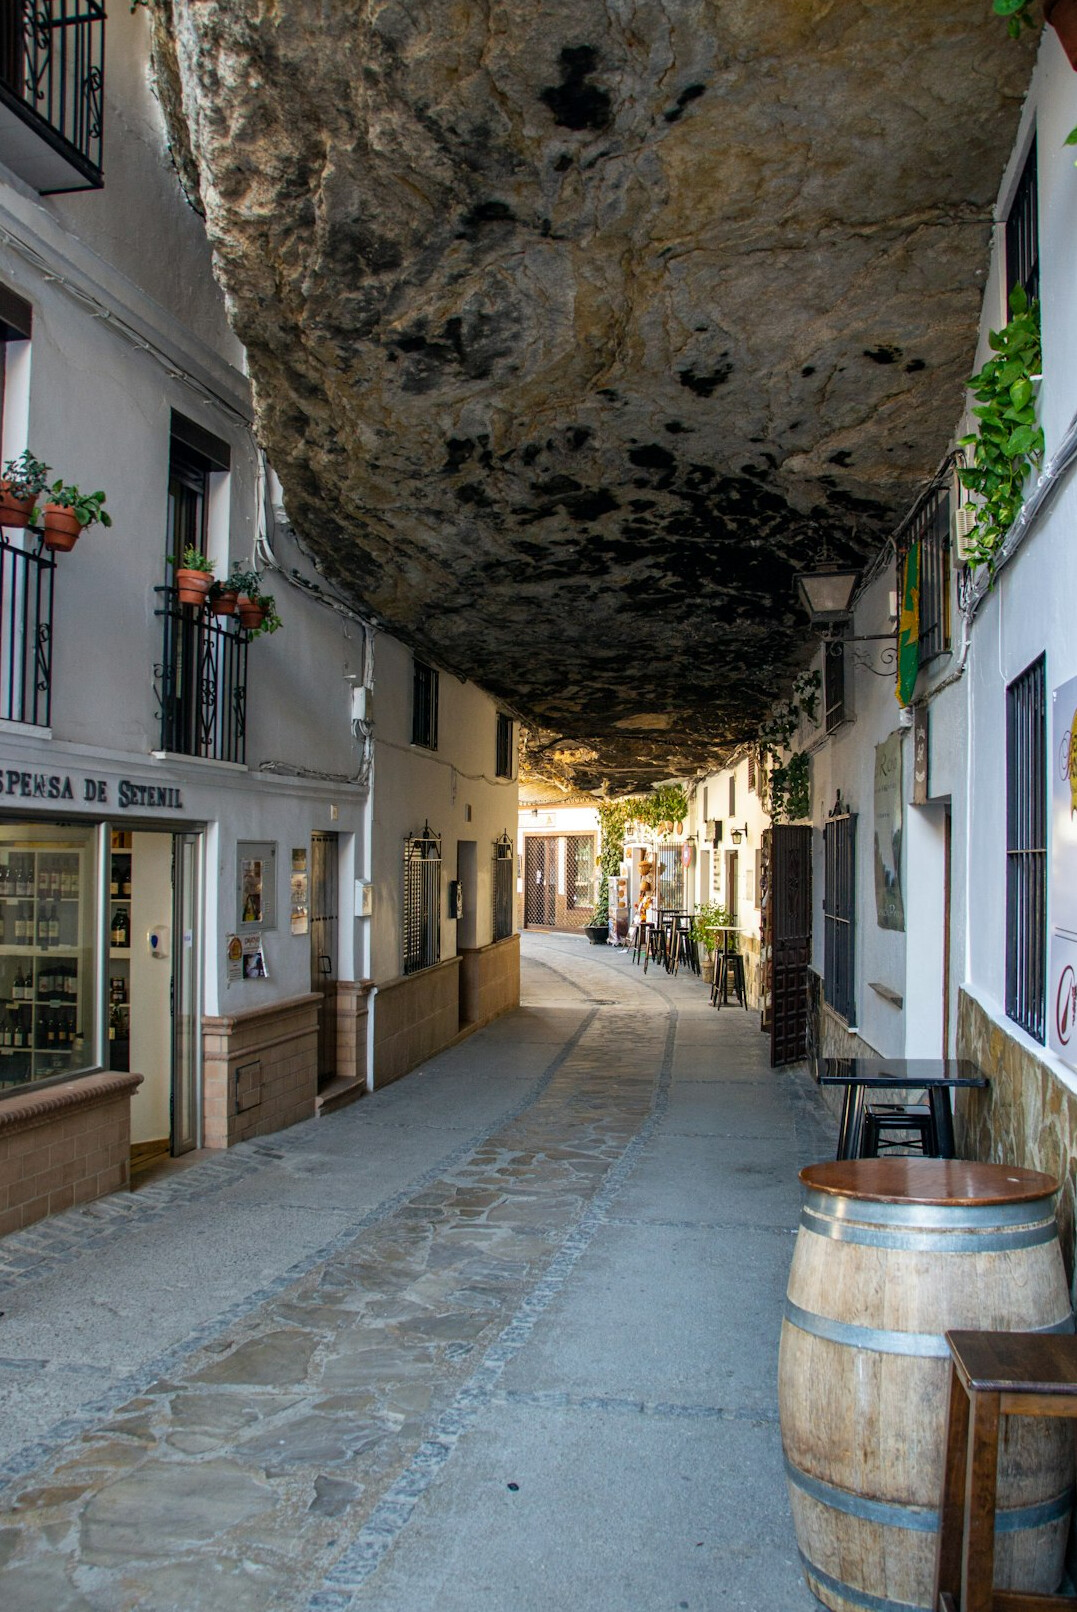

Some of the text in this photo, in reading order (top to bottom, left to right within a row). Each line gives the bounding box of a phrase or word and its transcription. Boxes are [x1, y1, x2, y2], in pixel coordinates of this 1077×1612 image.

[0, 769, 183, 808] PENSA DE SETENIL
